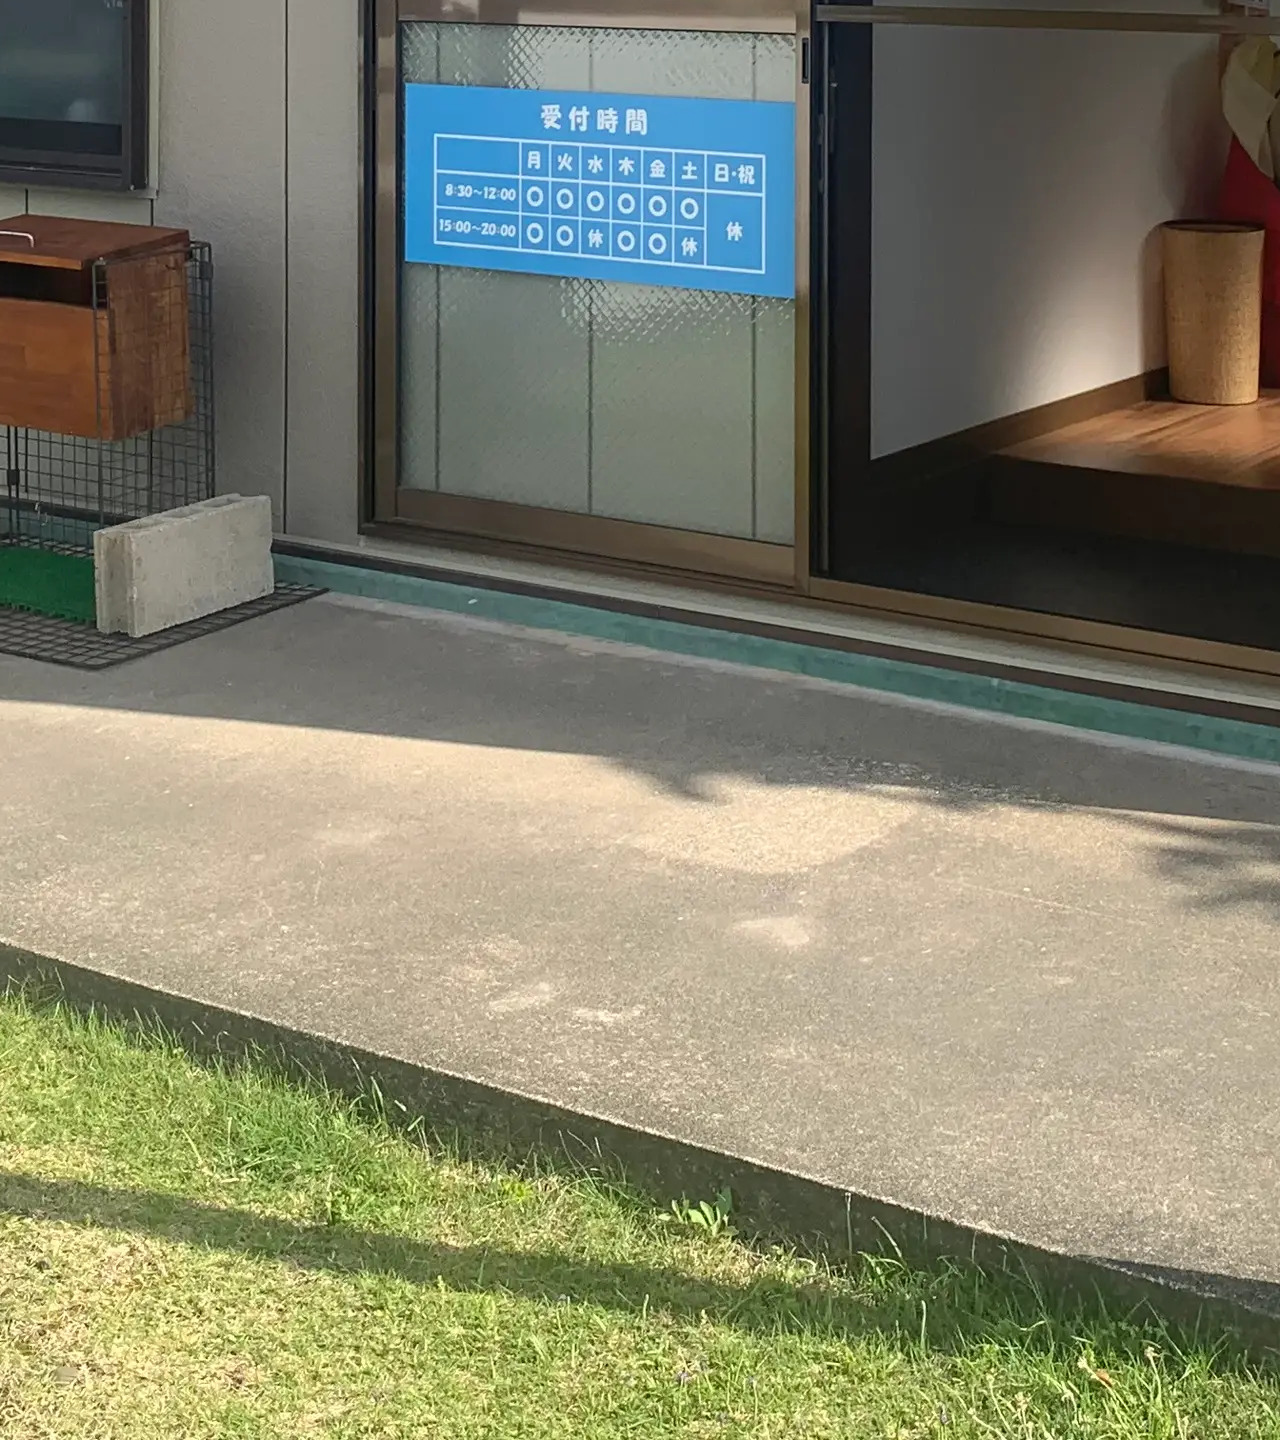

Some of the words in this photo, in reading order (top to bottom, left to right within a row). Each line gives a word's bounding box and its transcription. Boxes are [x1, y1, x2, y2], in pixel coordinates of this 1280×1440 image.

[540, 104, 648, 136] 受付時間
[527, 150, 541, 170] 月
[557, 152, 573, 172] 火
[587, 154, 604, 174] 水
[618, 156, 635, 176] 木
[649, 159, 666, 179] 金
[681, 160, 698, 180] 土
[587, 228, 604, 249] 休
[681, 236, 698, 257] 休
[726, 221, 743, 242] 休
